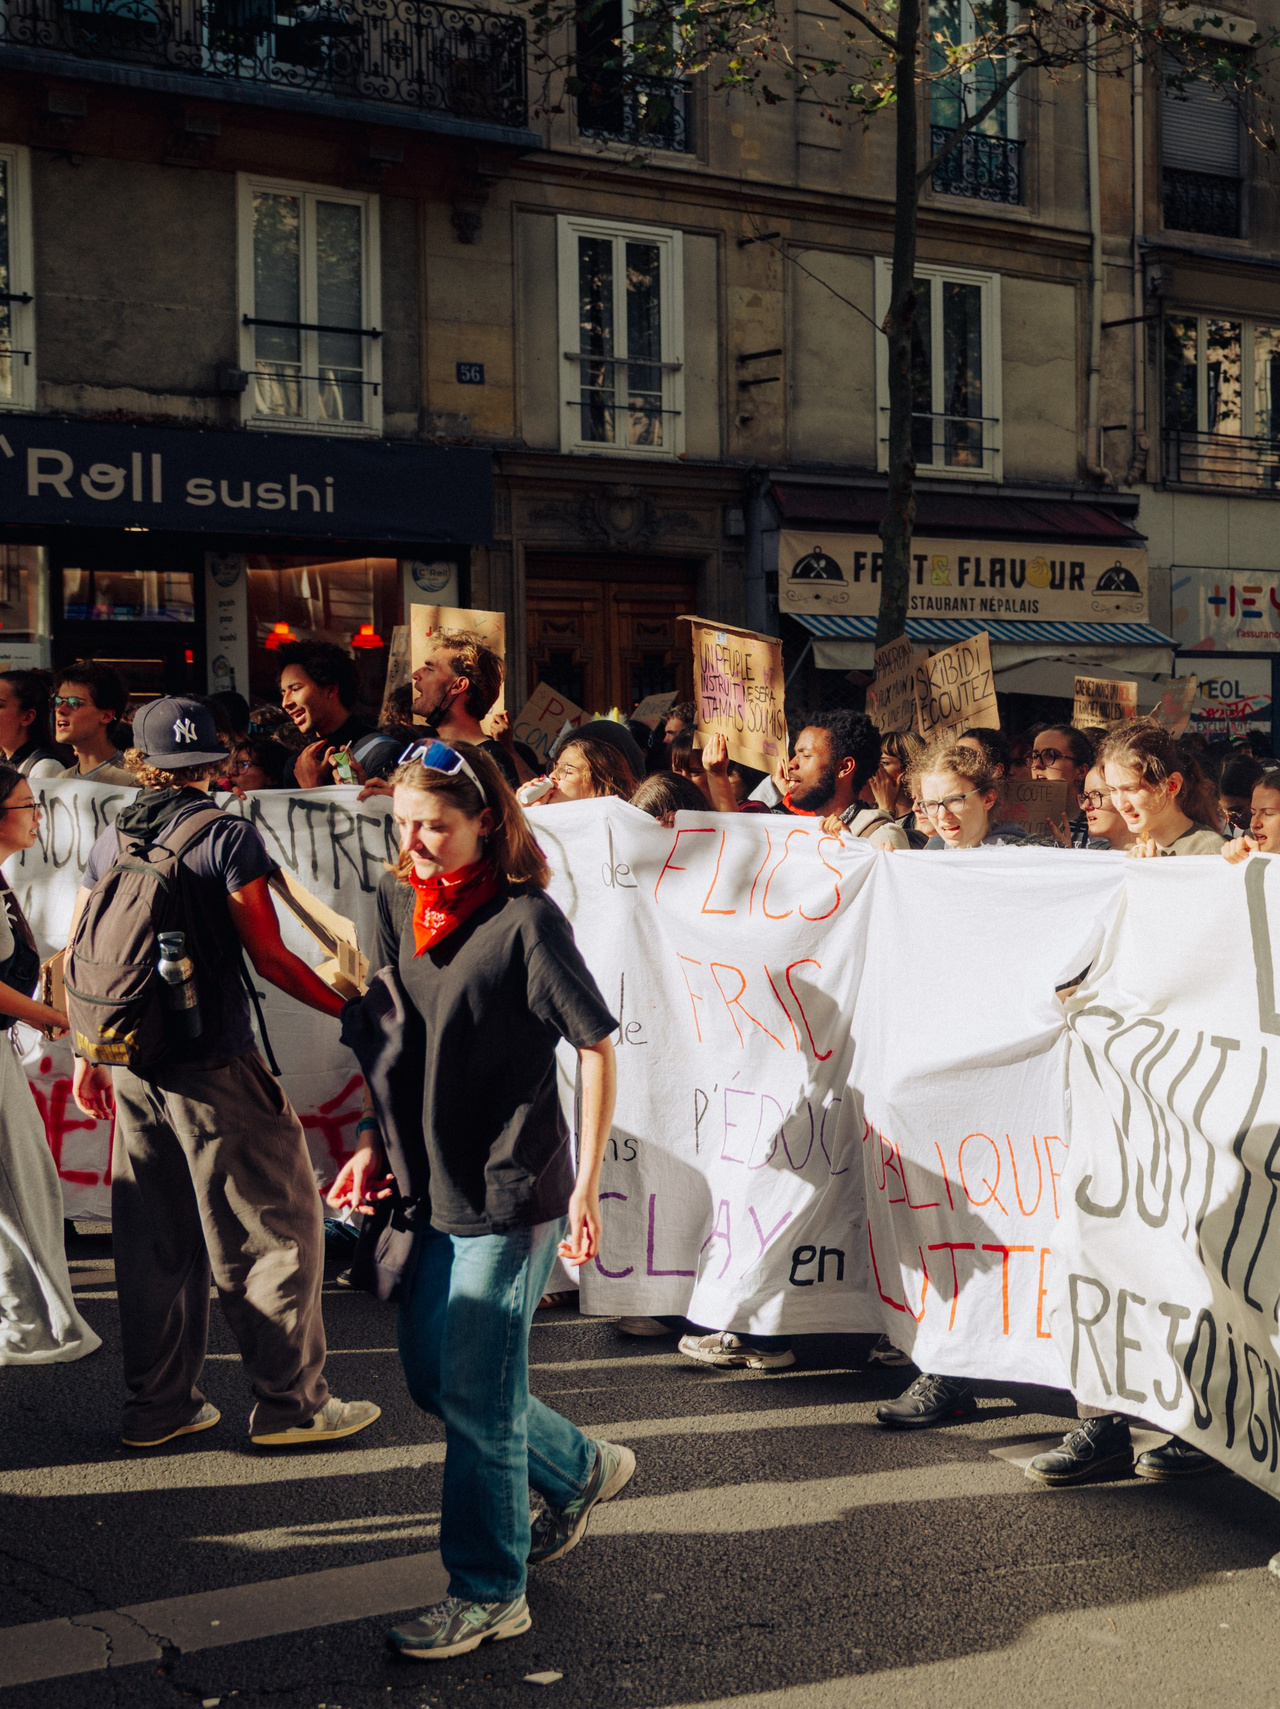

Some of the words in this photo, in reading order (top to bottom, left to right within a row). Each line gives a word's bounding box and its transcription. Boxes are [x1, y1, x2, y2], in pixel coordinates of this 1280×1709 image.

[460, 365, 481, 382] 56
[186, 475, 335, 513] sushi
[930, 554, 952, 587] &
[907, 595, 976, 613] STAURANT
[979, 597, 1039, 615] NÉPALAIS
[716, 643, 756, 681] PEUPLE
[174, 717, 198, 744] NY
[602, 816, 638, 889] de
[655, 827, 846, 921] FLICS
[676, 951, 834, 1062] FRIC
[788, 1241, 846, 1287] en
[866, 1218, 1055, 1340] LUTTE
